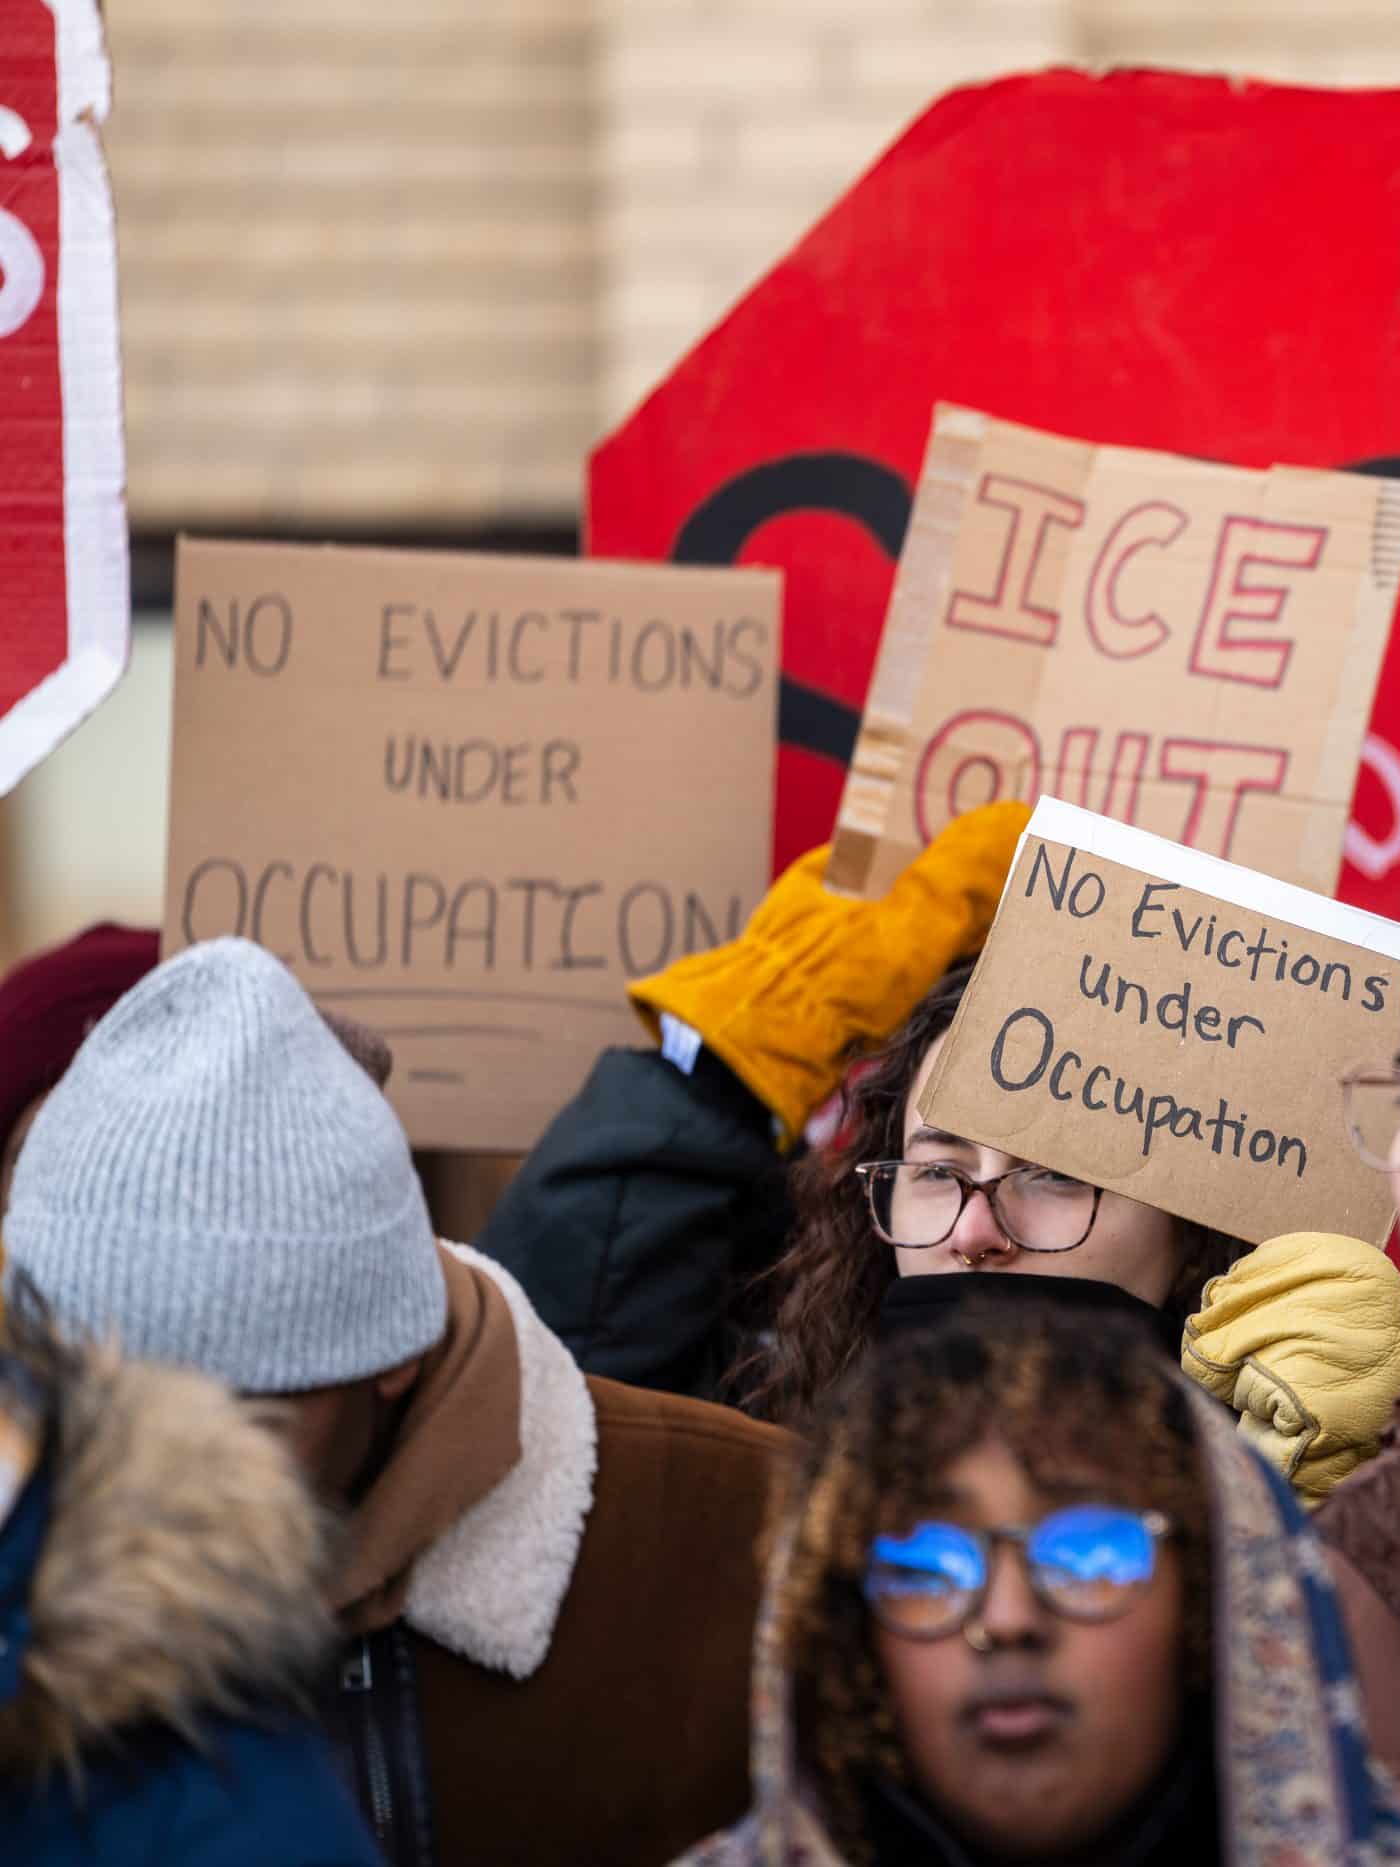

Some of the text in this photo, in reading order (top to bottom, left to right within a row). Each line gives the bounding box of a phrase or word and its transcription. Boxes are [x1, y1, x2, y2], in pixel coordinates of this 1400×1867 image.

[944, 473, 1329, 690] ICE
[194, 592, 770, 700] NO EVICTIONS
[383, 733, 582, 804] UNDER
[180, 856, 744, 978] OCCUPATION
[1024, 843, 1390, 1012] No Evictions
[1079, 954, 1265, 1048] under
[990, 1007, 1308, 1178] Occupation
